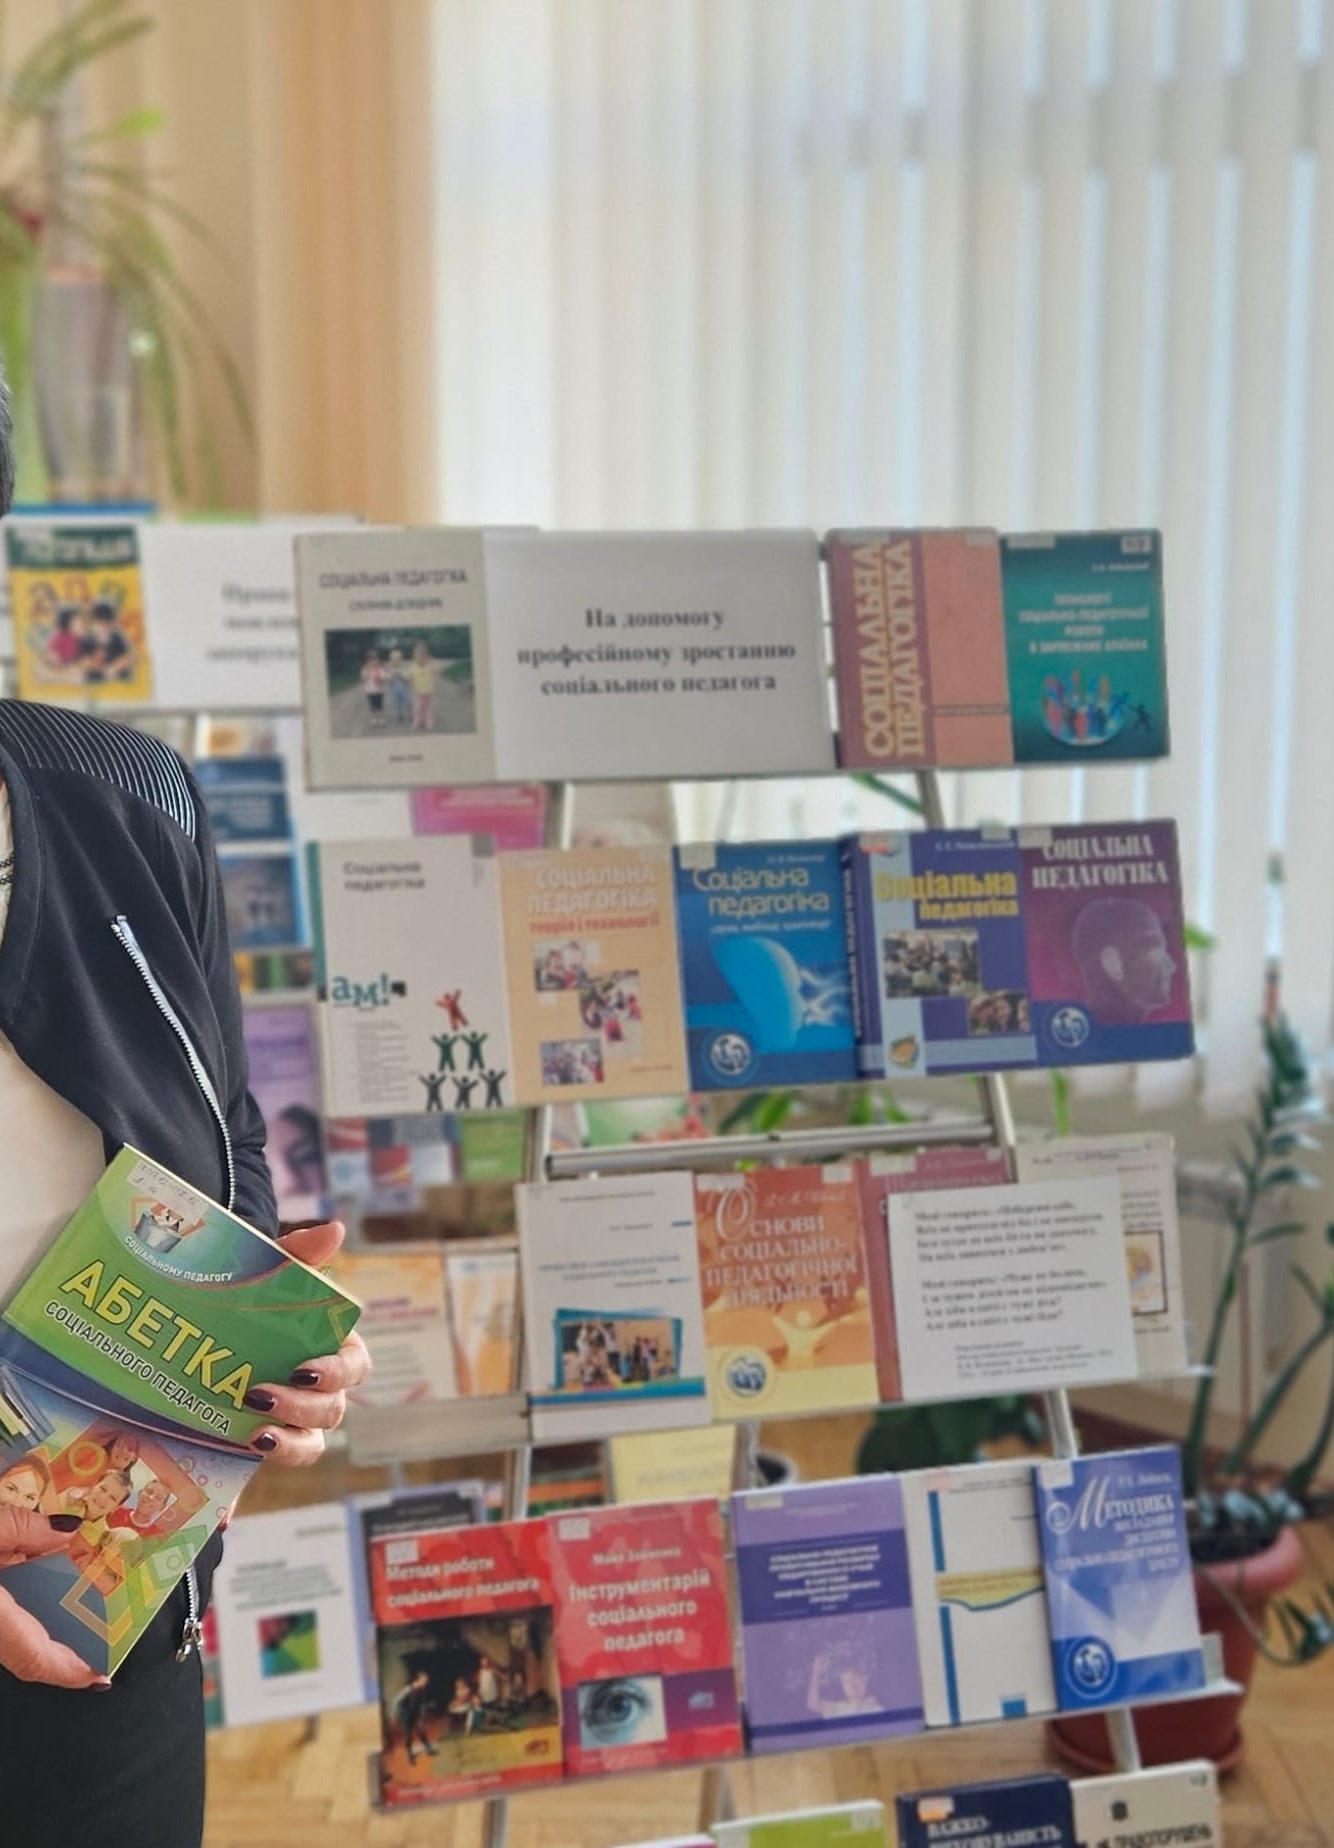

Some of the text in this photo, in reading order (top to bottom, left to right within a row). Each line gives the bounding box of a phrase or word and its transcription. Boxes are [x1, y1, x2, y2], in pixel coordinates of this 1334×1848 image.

[585, 608, 724, 631] На допомогу
[517, 638, 796, 668] професійному зростанню
[853, 538, 894, 756] СОЦІАЛЬНА
[883, 538, 924, 758] ПЕДАГОГІКА
[540, 674, 776, 698] соціального педагога
[1042, 834, 1153, 862] СОЦІАЛЬНА
[343, 861, 420, 879] Соціальна
[536, 865, 655, 890] СОЦІАЛЬНА
[692, 864, 809, 893] Соціальна
[1031, 861, 1168, 891] ПЕДАГОГІКА
[344, 876, 425, 894] педагогіка
[875, 871, 1017, 902] Соціальна
[527, 888, 657, 914] ПЕДАГОГІКА
[708, 891, 830, 919] педагогіка
[919, 899, 1019, 921] педагогіка
[529, 919, 574, 937] теорія
[584, 913, 659, 932] технології
[123, 1235, 233, 1283] СОЦІАЛЬНОМУ ПЕДАГОГУ
[720, 1237, 845, 1262] СОЦІАЛЬНО-
[706, 1255, 859, 1287] ПЕДАГОГІЧНОЇ
[59, 1259, 255, 1411] АБЕТКА
[44, 1299, 231, 1434] СОЦІАЛЬНОГО ПЕДАГОГА
[385, 1555, 494, 1582] Методи роботи
[387, 1577, 539, 1609] соціального педагога
[570, 1568, 711, 1602] Інструментарій
[587, 1598, 697, 1629] соціального
[603, 1626, 685, 1653] педагога
